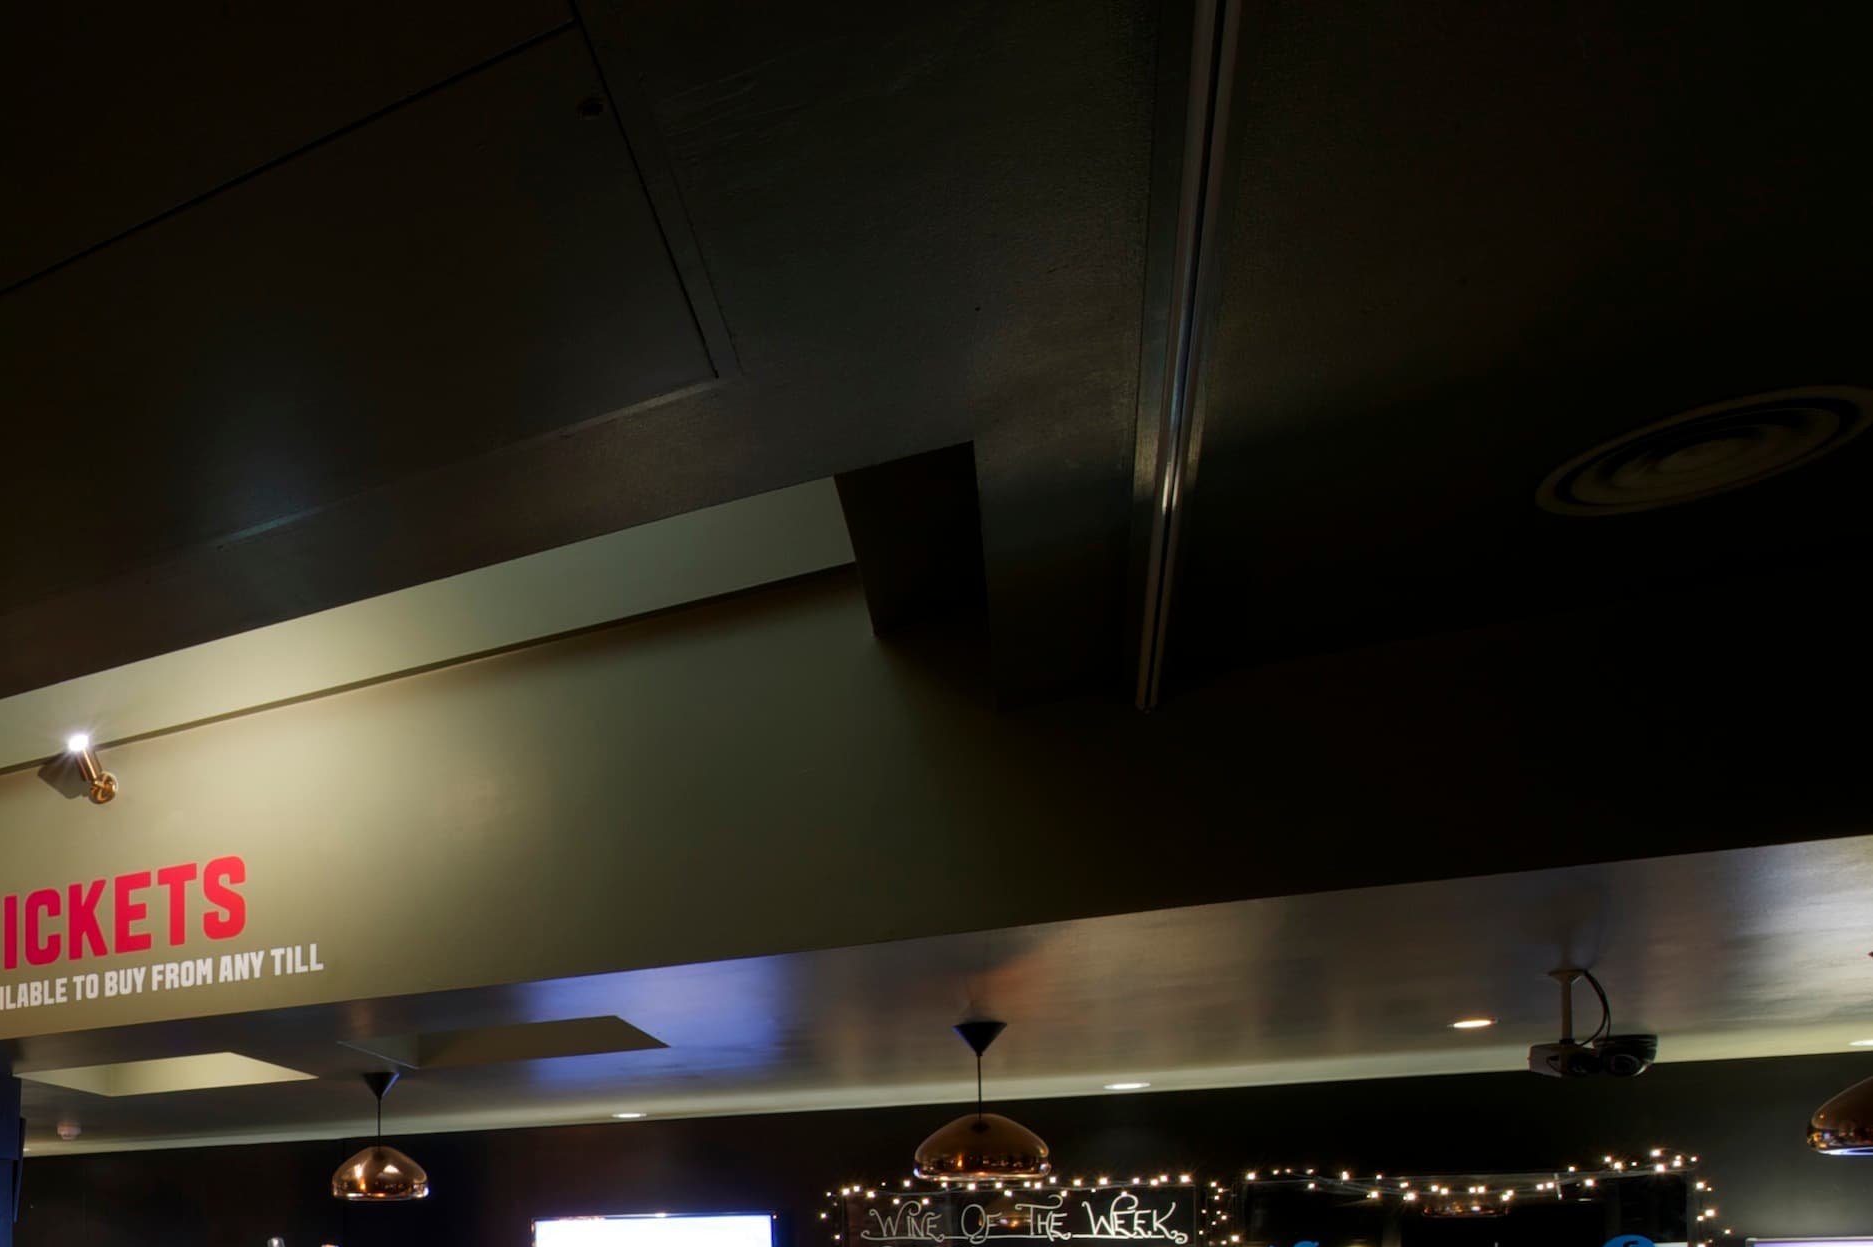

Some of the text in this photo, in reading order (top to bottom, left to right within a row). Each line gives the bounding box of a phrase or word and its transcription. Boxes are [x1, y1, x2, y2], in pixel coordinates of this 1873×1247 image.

[73, 972, 99, 1001] TO
[104, 966, 147, 997] BUY
[151, 957, 213, 991] FROM
[219, 950, 263, 982] ANY
[270, 943, 324, 975] TILL
[869, 1194, 1188, 1244] WINE OF THE WEEK
